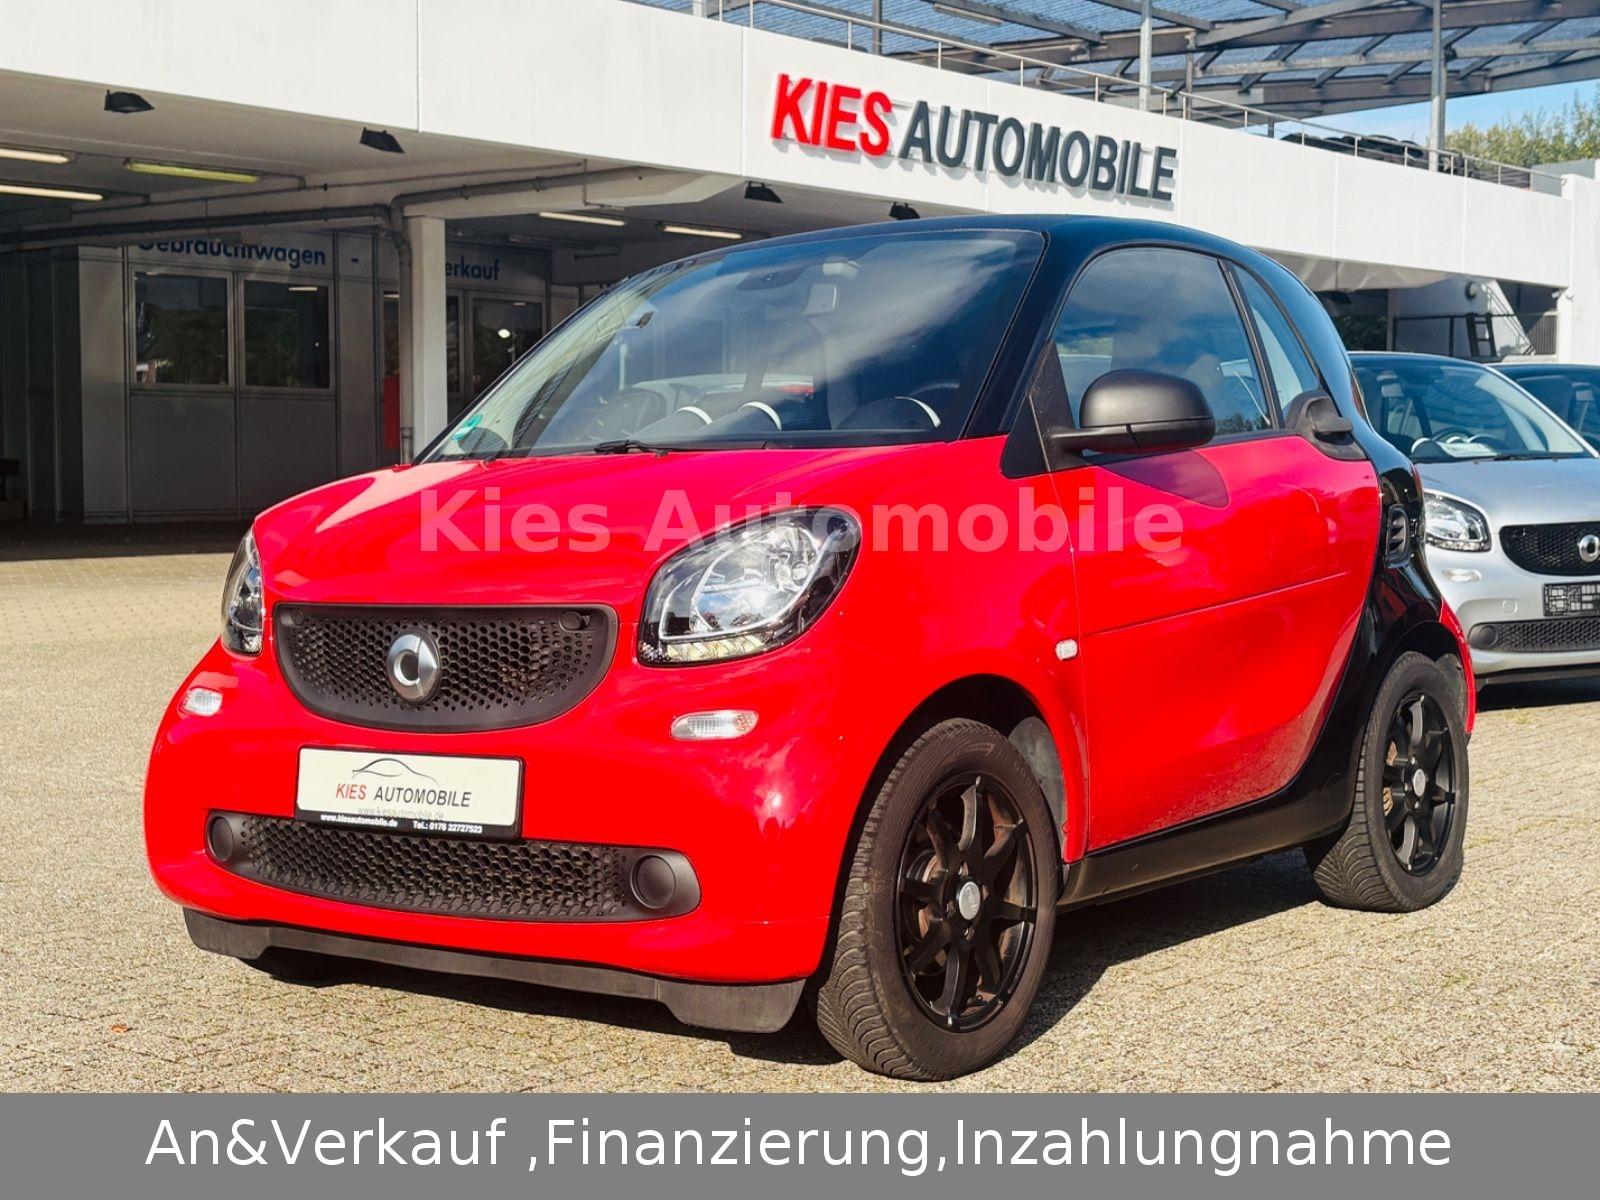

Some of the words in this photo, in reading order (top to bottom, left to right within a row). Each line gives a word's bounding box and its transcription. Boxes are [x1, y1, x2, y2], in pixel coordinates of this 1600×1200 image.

[771, 73, 893, 157] KIES
[900, 100, 1178, 201] AUTOMOBILE
[445, 255, 501, 280] erkauf
[335, 783, 367, 800] KIES
[373, 786, 472, 808] AUTOMOBILE
[320, 814, 398, 828] www.kiesautomobile.de
